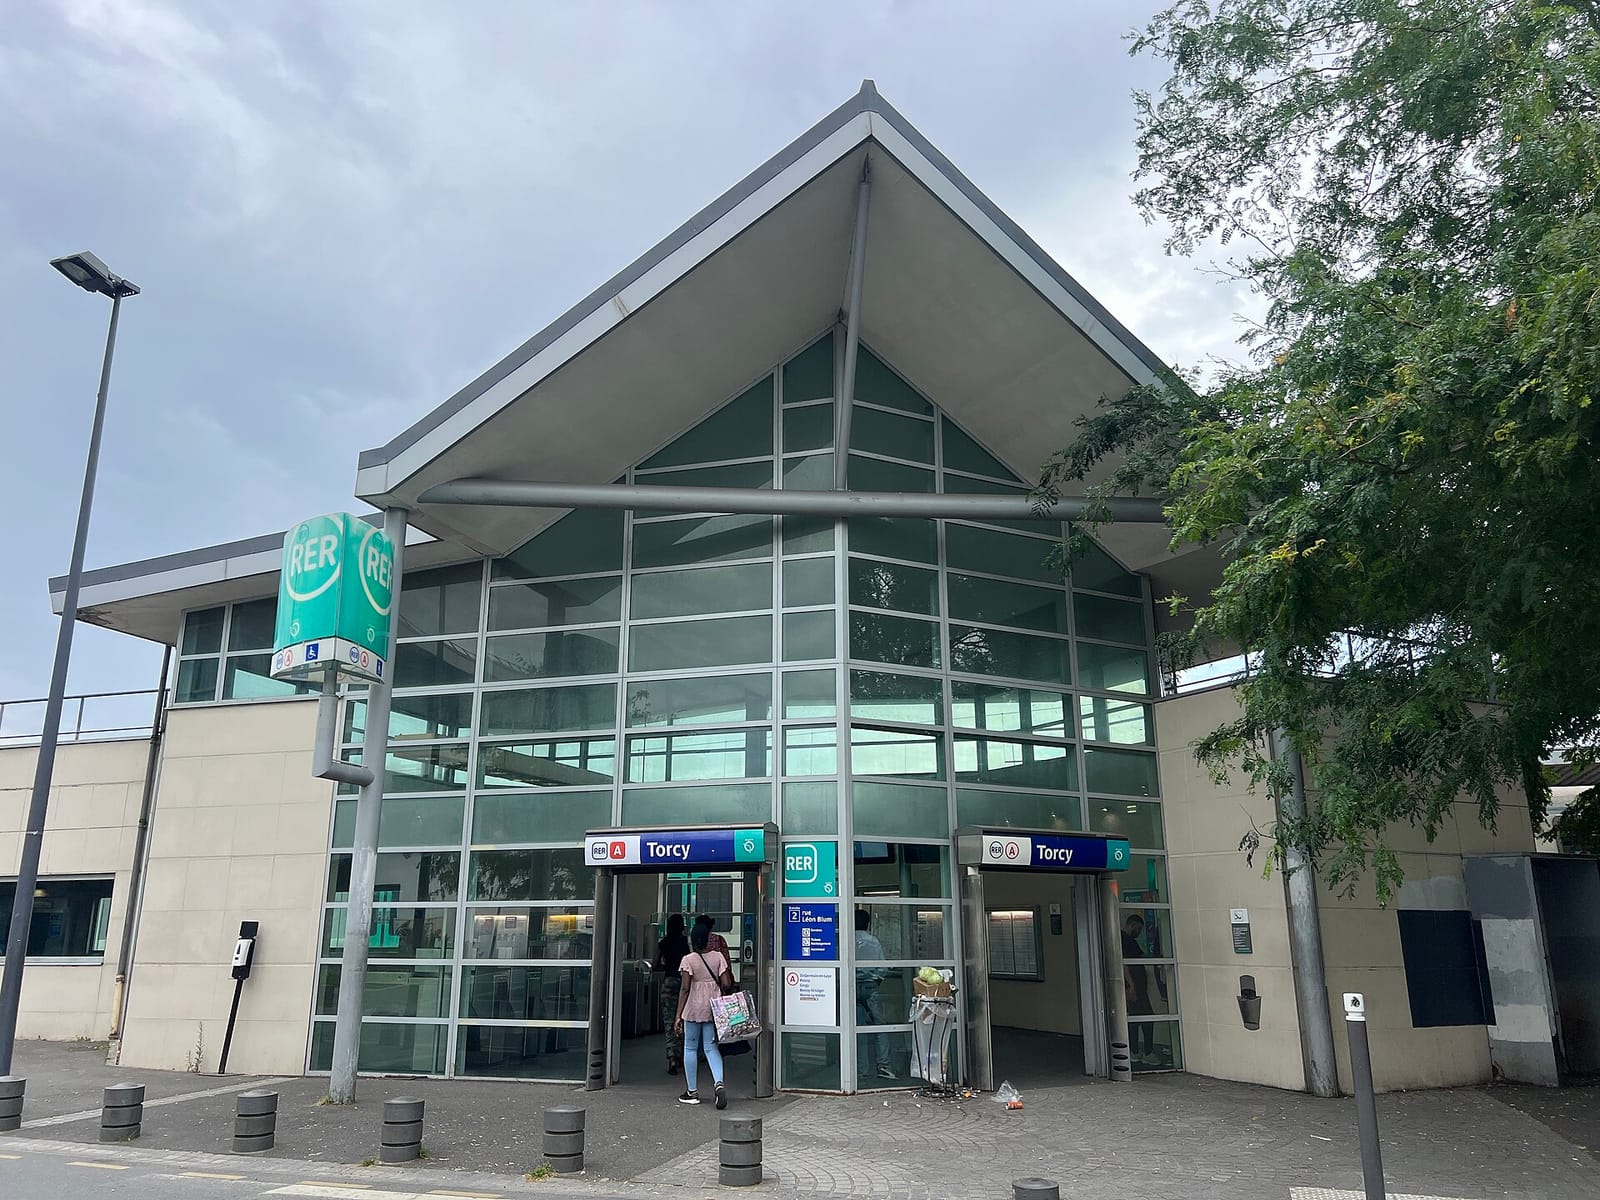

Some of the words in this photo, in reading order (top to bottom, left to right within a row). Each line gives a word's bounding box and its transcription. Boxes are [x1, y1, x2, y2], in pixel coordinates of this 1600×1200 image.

[291, 536, 338, 576] RER
[593, 847, 606, 855] RER
[613, 845, 622, 856] A
[646, 842, 690, 860] Torcy
[991, 846, 1002, 854] RER
[1009, 846, 1015, 856] A
[1036, 844, 1073, 864] Torcy
[786, 856, 813, 871] RER
[791, 911, 798, 920] 2
[790, 975, 796, 983] A
